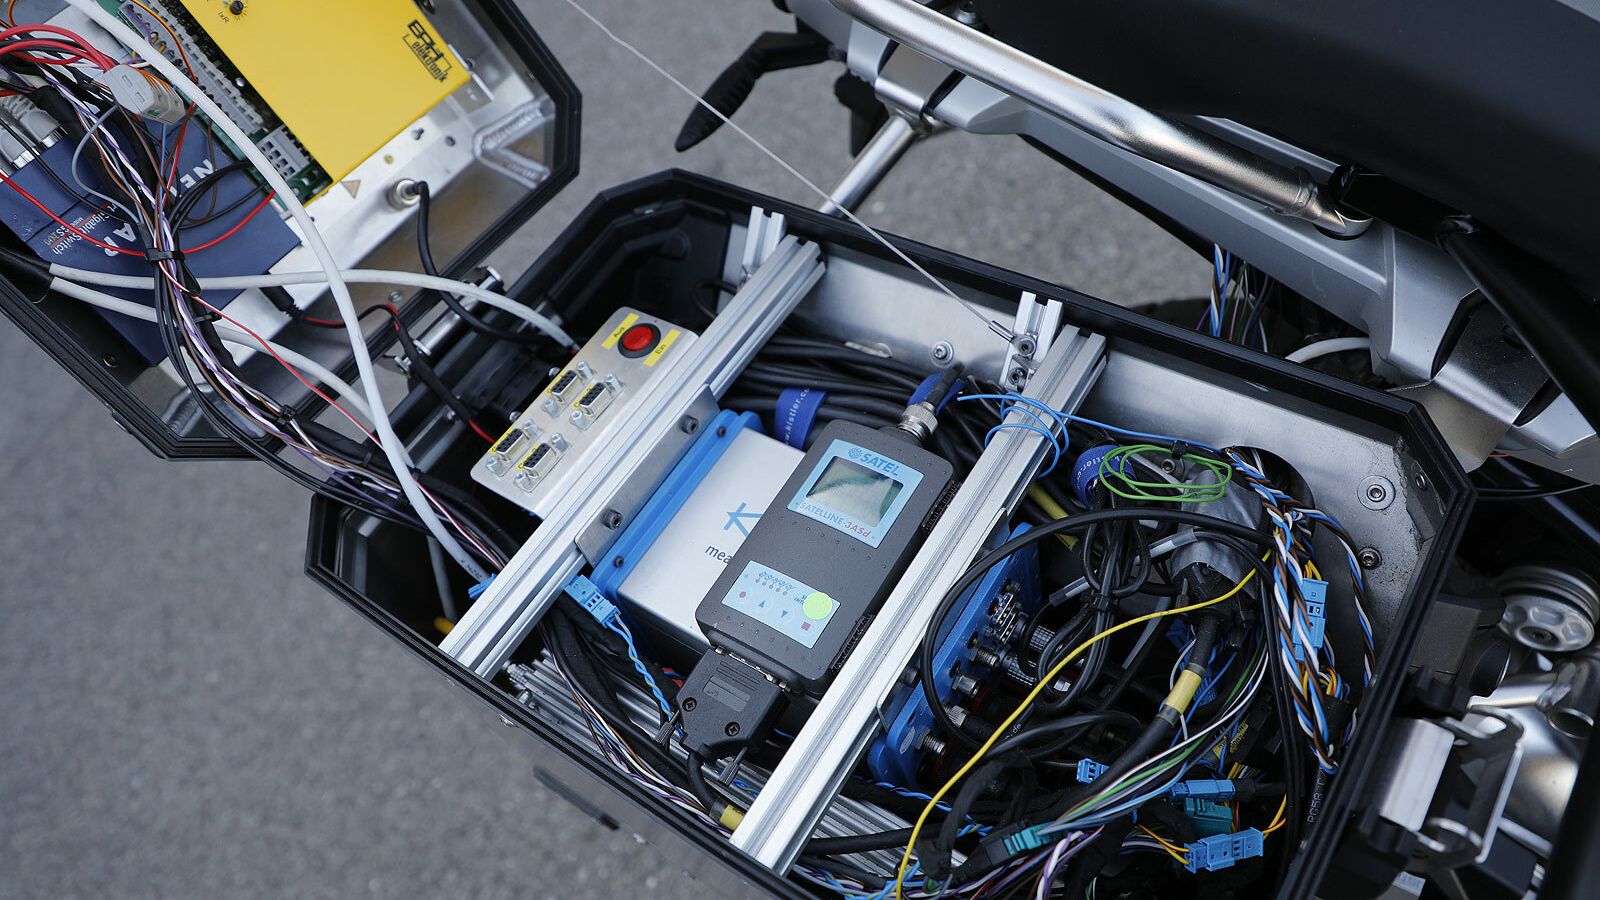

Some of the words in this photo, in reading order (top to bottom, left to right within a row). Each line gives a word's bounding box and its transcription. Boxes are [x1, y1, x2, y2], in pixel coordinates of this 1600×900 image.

[411, 41, 448, 82] elektronik
[51, 231, 82, 255] Switch
[859, 452, 903, 477] SATEL
[704, 544, 733, 564] mea
